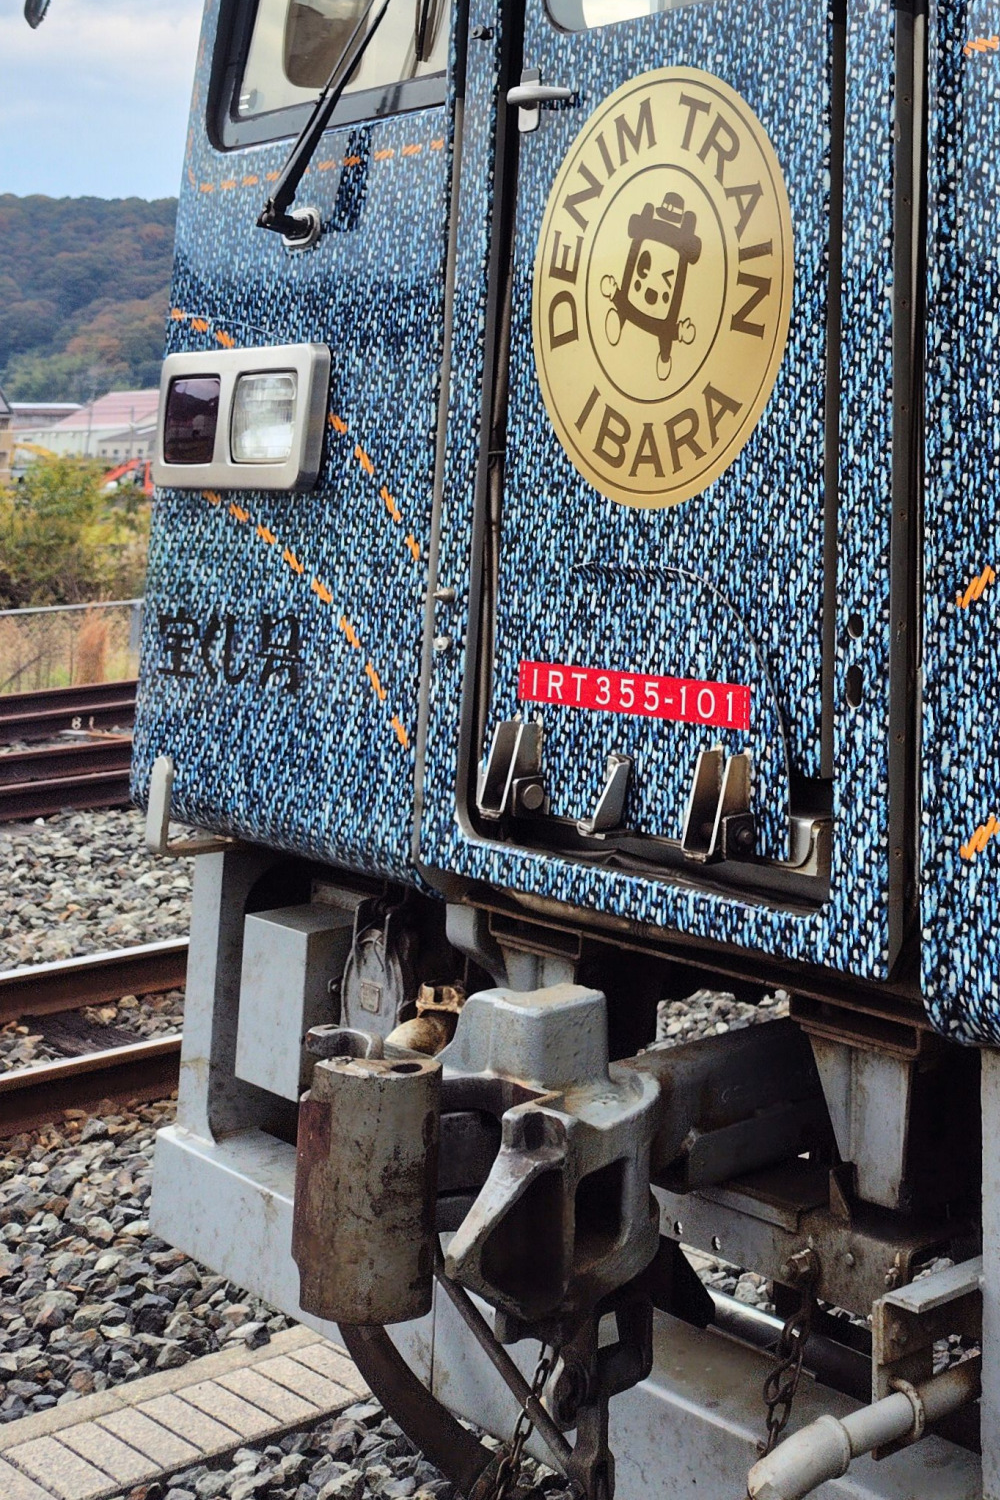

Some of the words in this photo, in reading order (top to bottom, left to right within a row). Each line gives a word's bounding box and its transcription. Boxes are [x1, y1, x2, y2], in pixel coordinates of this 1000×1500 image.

[548, 96, 657, 353] DENIM
[678, 92, 774, 340] TRAIN
[573, 381, 743, 479] IBARA
[531, 668, 734, 723] IRT355-101
